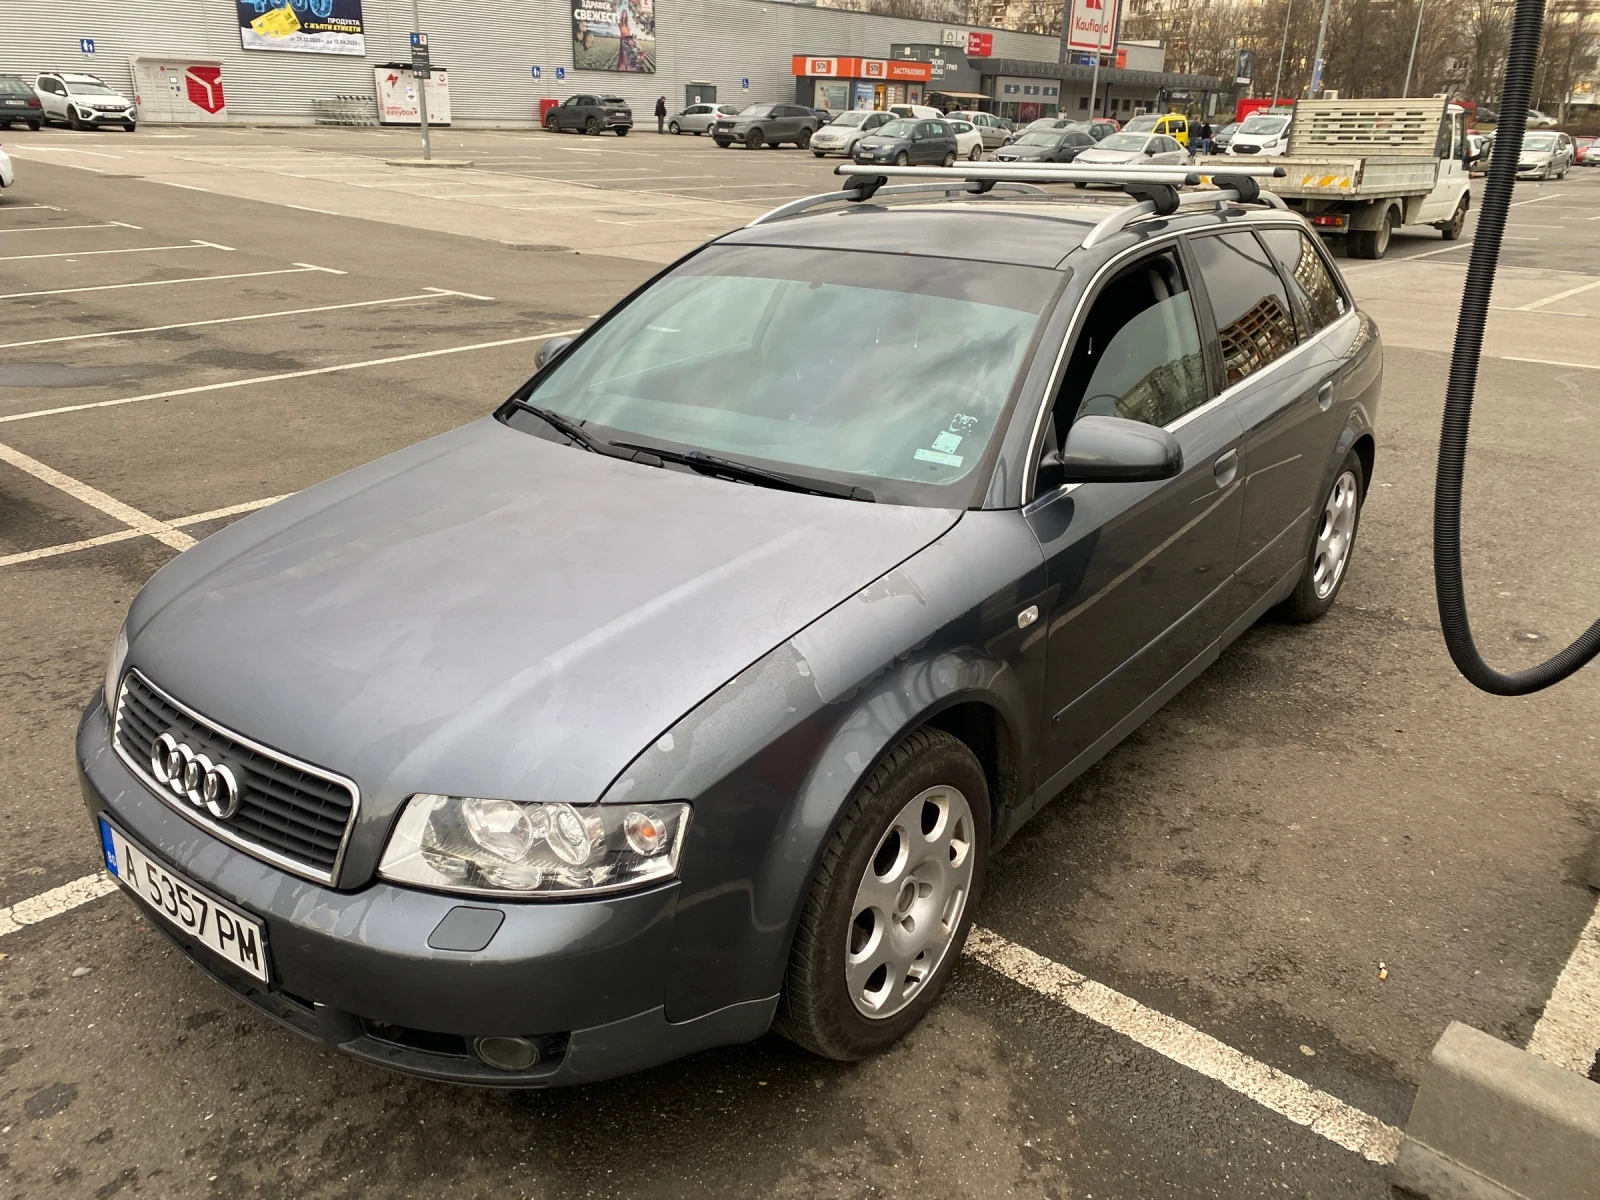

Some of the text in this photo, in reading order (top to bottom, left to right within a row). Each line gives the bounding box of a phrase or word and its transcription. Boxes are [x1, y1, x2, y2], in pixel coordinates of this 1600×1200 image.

[574, 9, 621, 23] СВЕЖЕСТ!
[327, 17, 361, 26] ПРОДУКТА
[1076, 16, 1109, 33] Kauflad
[309, 22, 332, 30] ЖЪЛТИ
[333, 24, 361, 33] ЕТИКЕТИ
[816, 62, 826, 70] SDI
[946, 63, 958, 71] ГРИЛ
[893, 67, 926, 76] ЗАСТРАХОВКИ
[386, 109, 413, 117] easybox
[107, 851, 117, 868] BG
[125, 845, 260, 972] A 5357 PM
